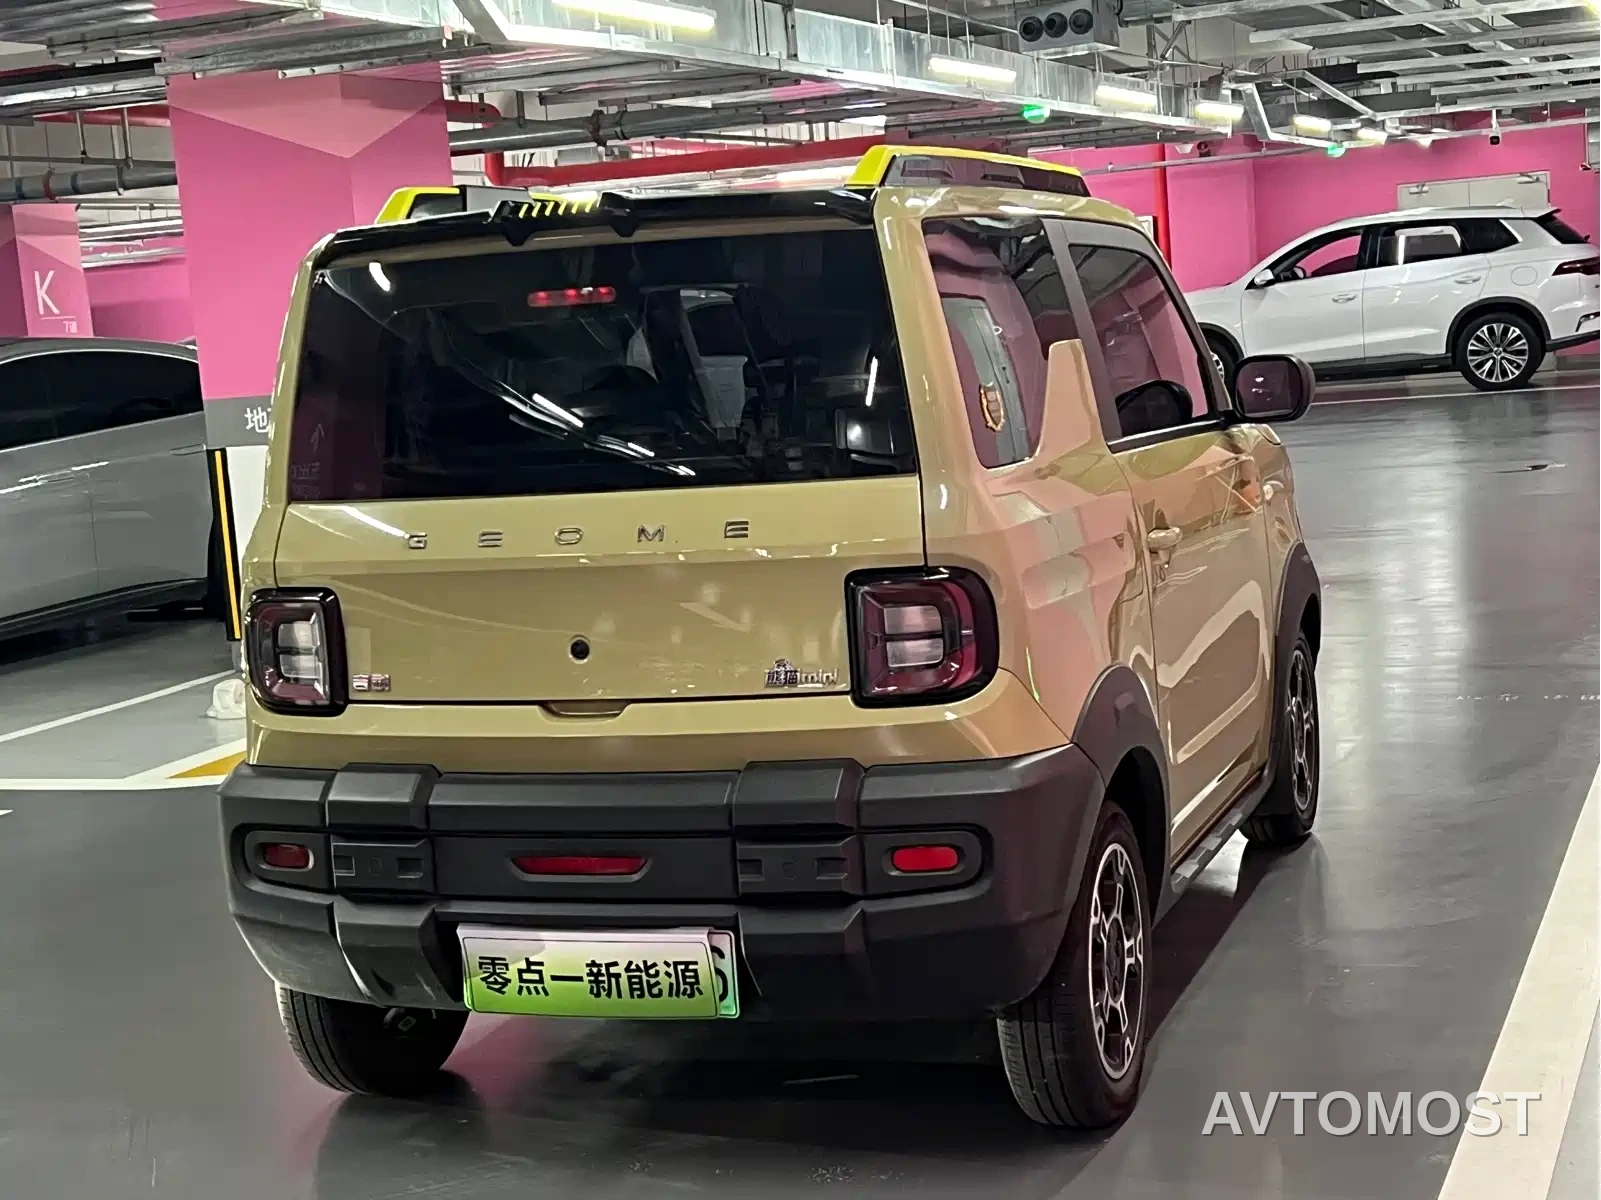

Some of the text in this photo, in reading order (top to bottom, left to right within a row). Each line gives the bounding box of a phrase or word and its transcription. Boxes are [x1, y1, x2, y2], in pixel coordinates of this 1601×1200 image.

[34, 270, 60, 315] K
[407, 520, 749, 550] GEOME
[477, 955, 705, 1000] 零点一新能源
